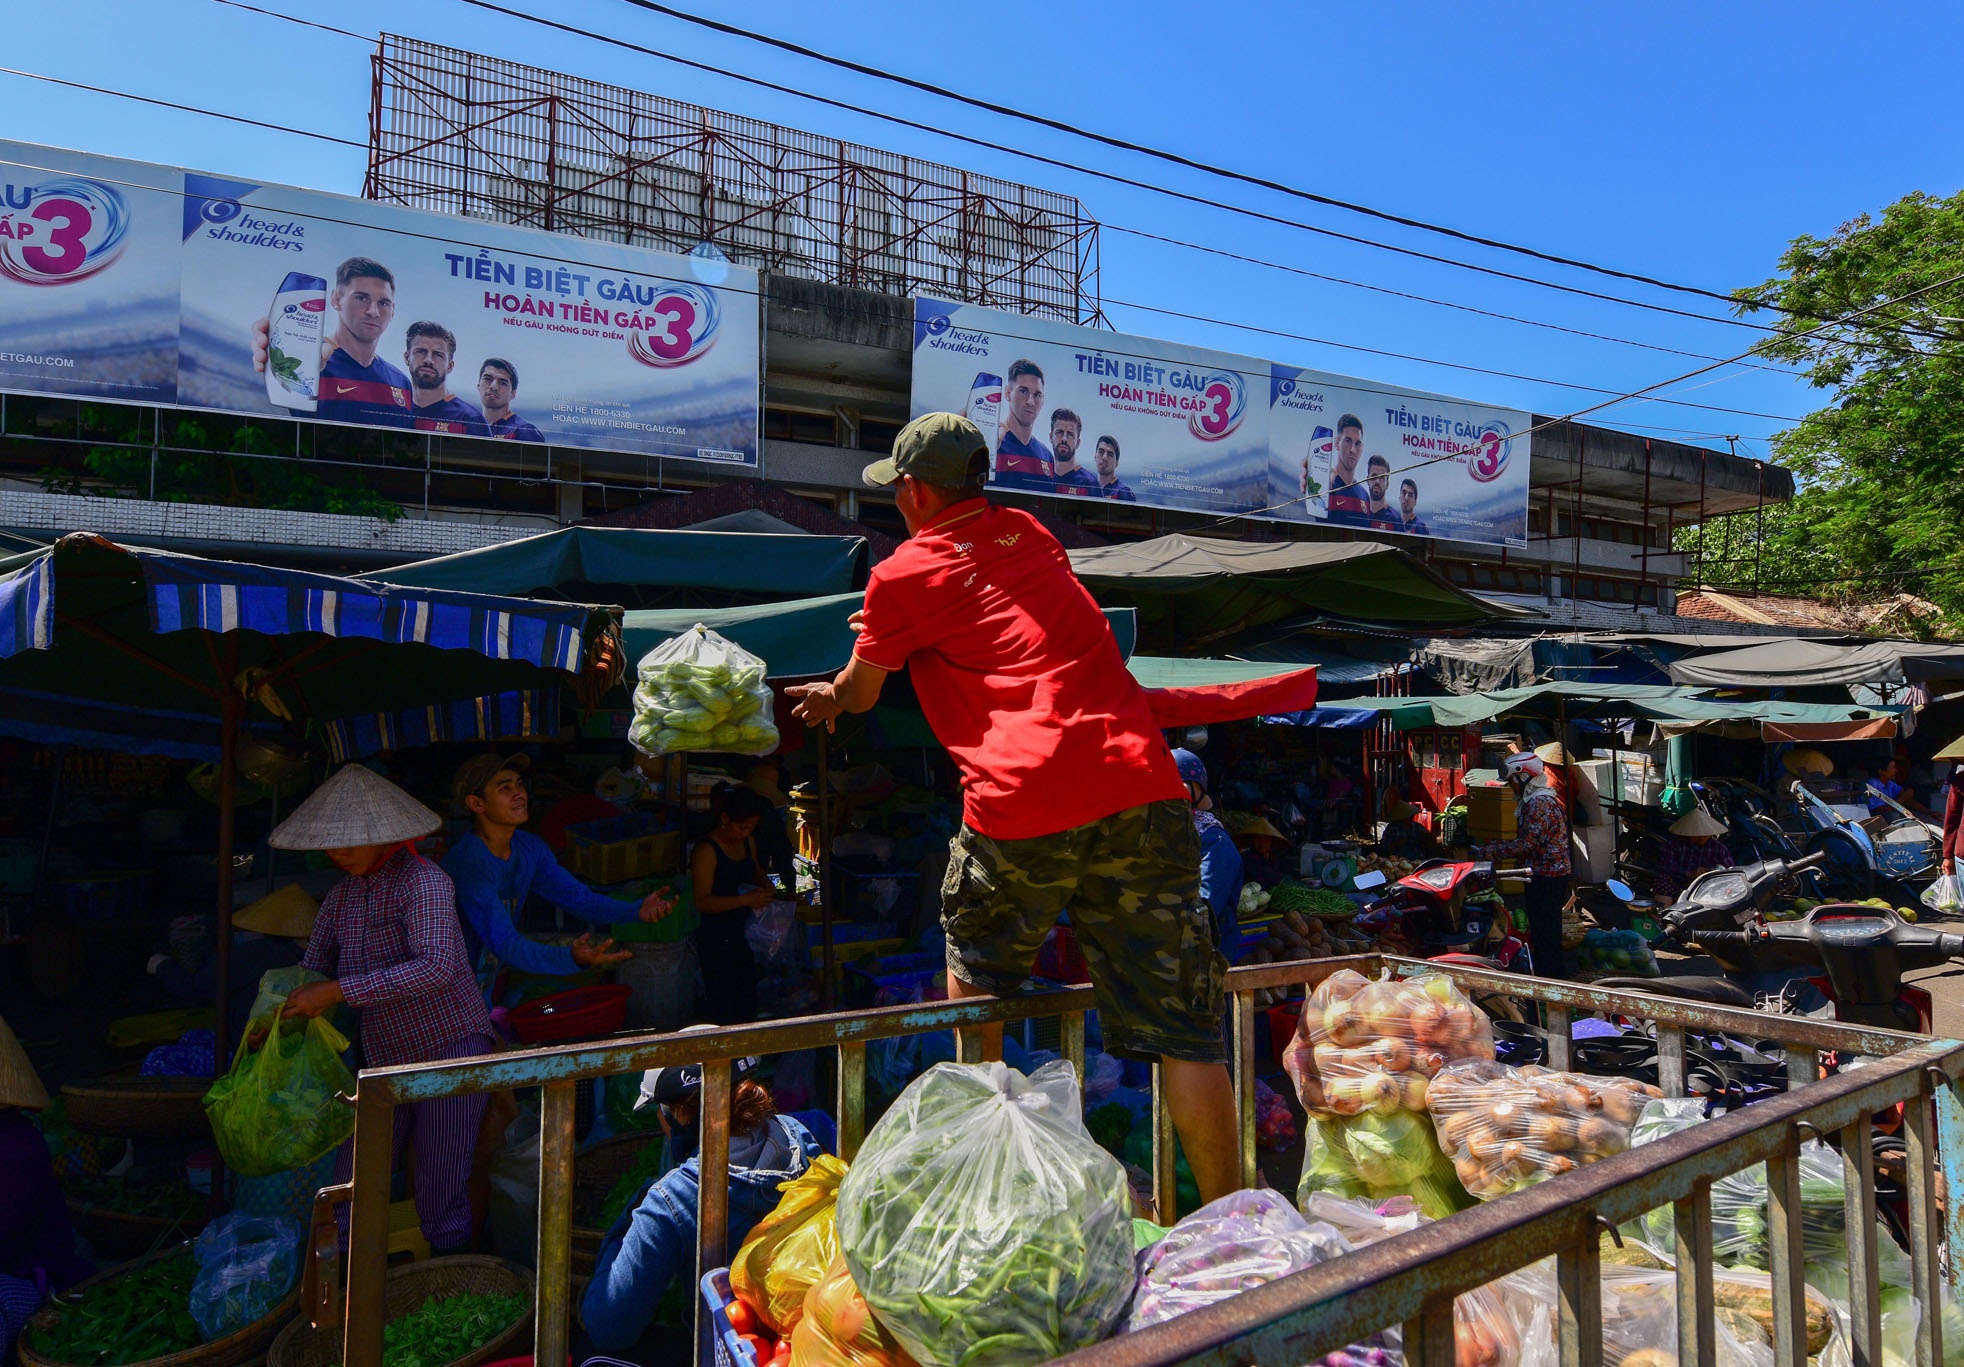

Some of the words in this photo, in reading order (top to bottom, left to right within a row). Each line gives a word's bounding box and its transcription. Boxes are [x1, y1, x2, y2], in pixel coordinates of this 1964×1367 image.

[0, 184, 32, 210] U
[22, 199, 92, 275] 3
[206, 226, 305, 252] shoulders
[444, 248, 515, 286] TIỄN
[525, 266, 591, 298] BIỆT
[484, 291, 555, 318] HOÀN
[559, 298, 609, 326] TIỀN
[614, 308, 657, 331] GẤP
[648, 296, 696, 359] 3
[546, 323, 580, 335] KHÔNG
[929, 337, 990, 357] shoulders
[1125, 361, 1166, 387] BIỆT
[1099, 382, 1143, 403] HOÀN
[1146, 387, 1177, 408] TIỀN
[1180, 394, 1207, 412] GẤP
[1201, 384, 1232, 434] 3
[1280, 397, 1324, 413] shoulders
[581, 417, 686, 436] WWW.TIENBIETGAU.COM
[1421, 414, 1452, 436] BIỆT
[1402, 433, 1435, 450] HOÀN
[1437, 435, 1460, 454] TIỀN
[1478, 432, 1501, 476] 3
